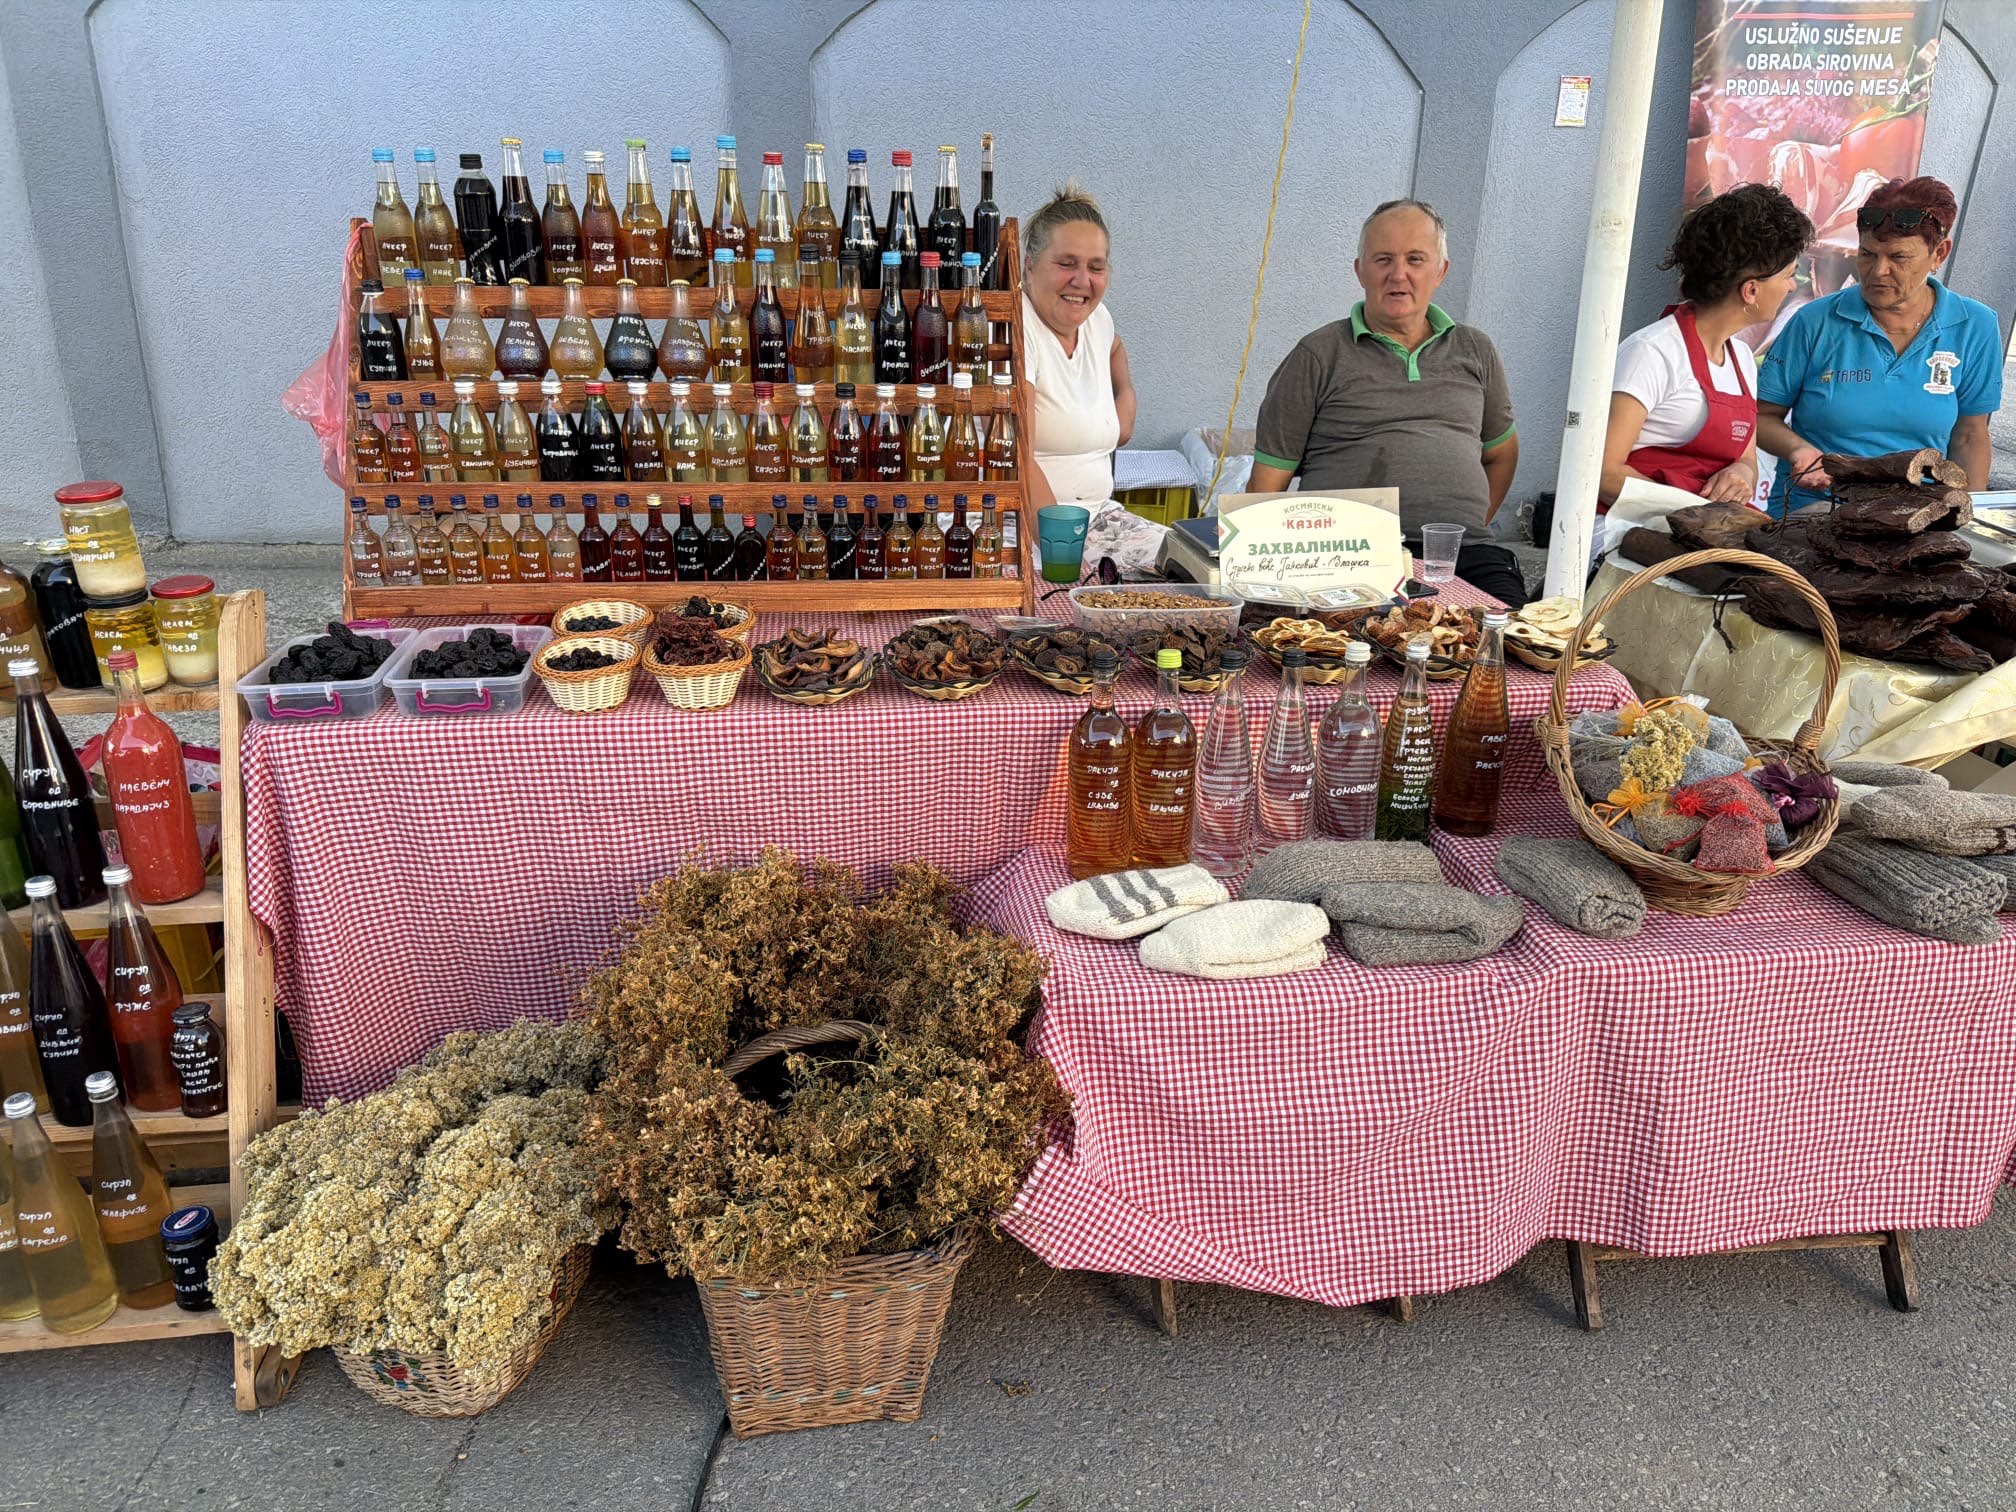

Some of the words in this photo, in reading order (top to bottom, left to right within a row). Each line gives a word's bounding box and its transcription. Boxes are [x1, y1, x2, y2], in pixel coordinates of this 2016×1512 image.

[1745, 22, 1820, 45] USLUŽNO
[1823, 23, 1903, 45] SUŠENJE
[1746, 54, 1812, 71] OBRADA
[1816, 53, 1895, 71] SIROVINA
[1725, 79, 1801, 97] PRODAJA
[1804, 80, 1854, 97] SUVOG
[1859, 79, 1911, 96] MESA
[1286, 516, 1332, 530] КАЗАН
[1247, 538, 1371, 556] ЗАХВАЛНИЦА
[1087, 765, 1119, 775] РАКИЈА
[119, 778, 170, 793] МЛЕВЕНИ
[115, 965, 149, 978] СИРУП
